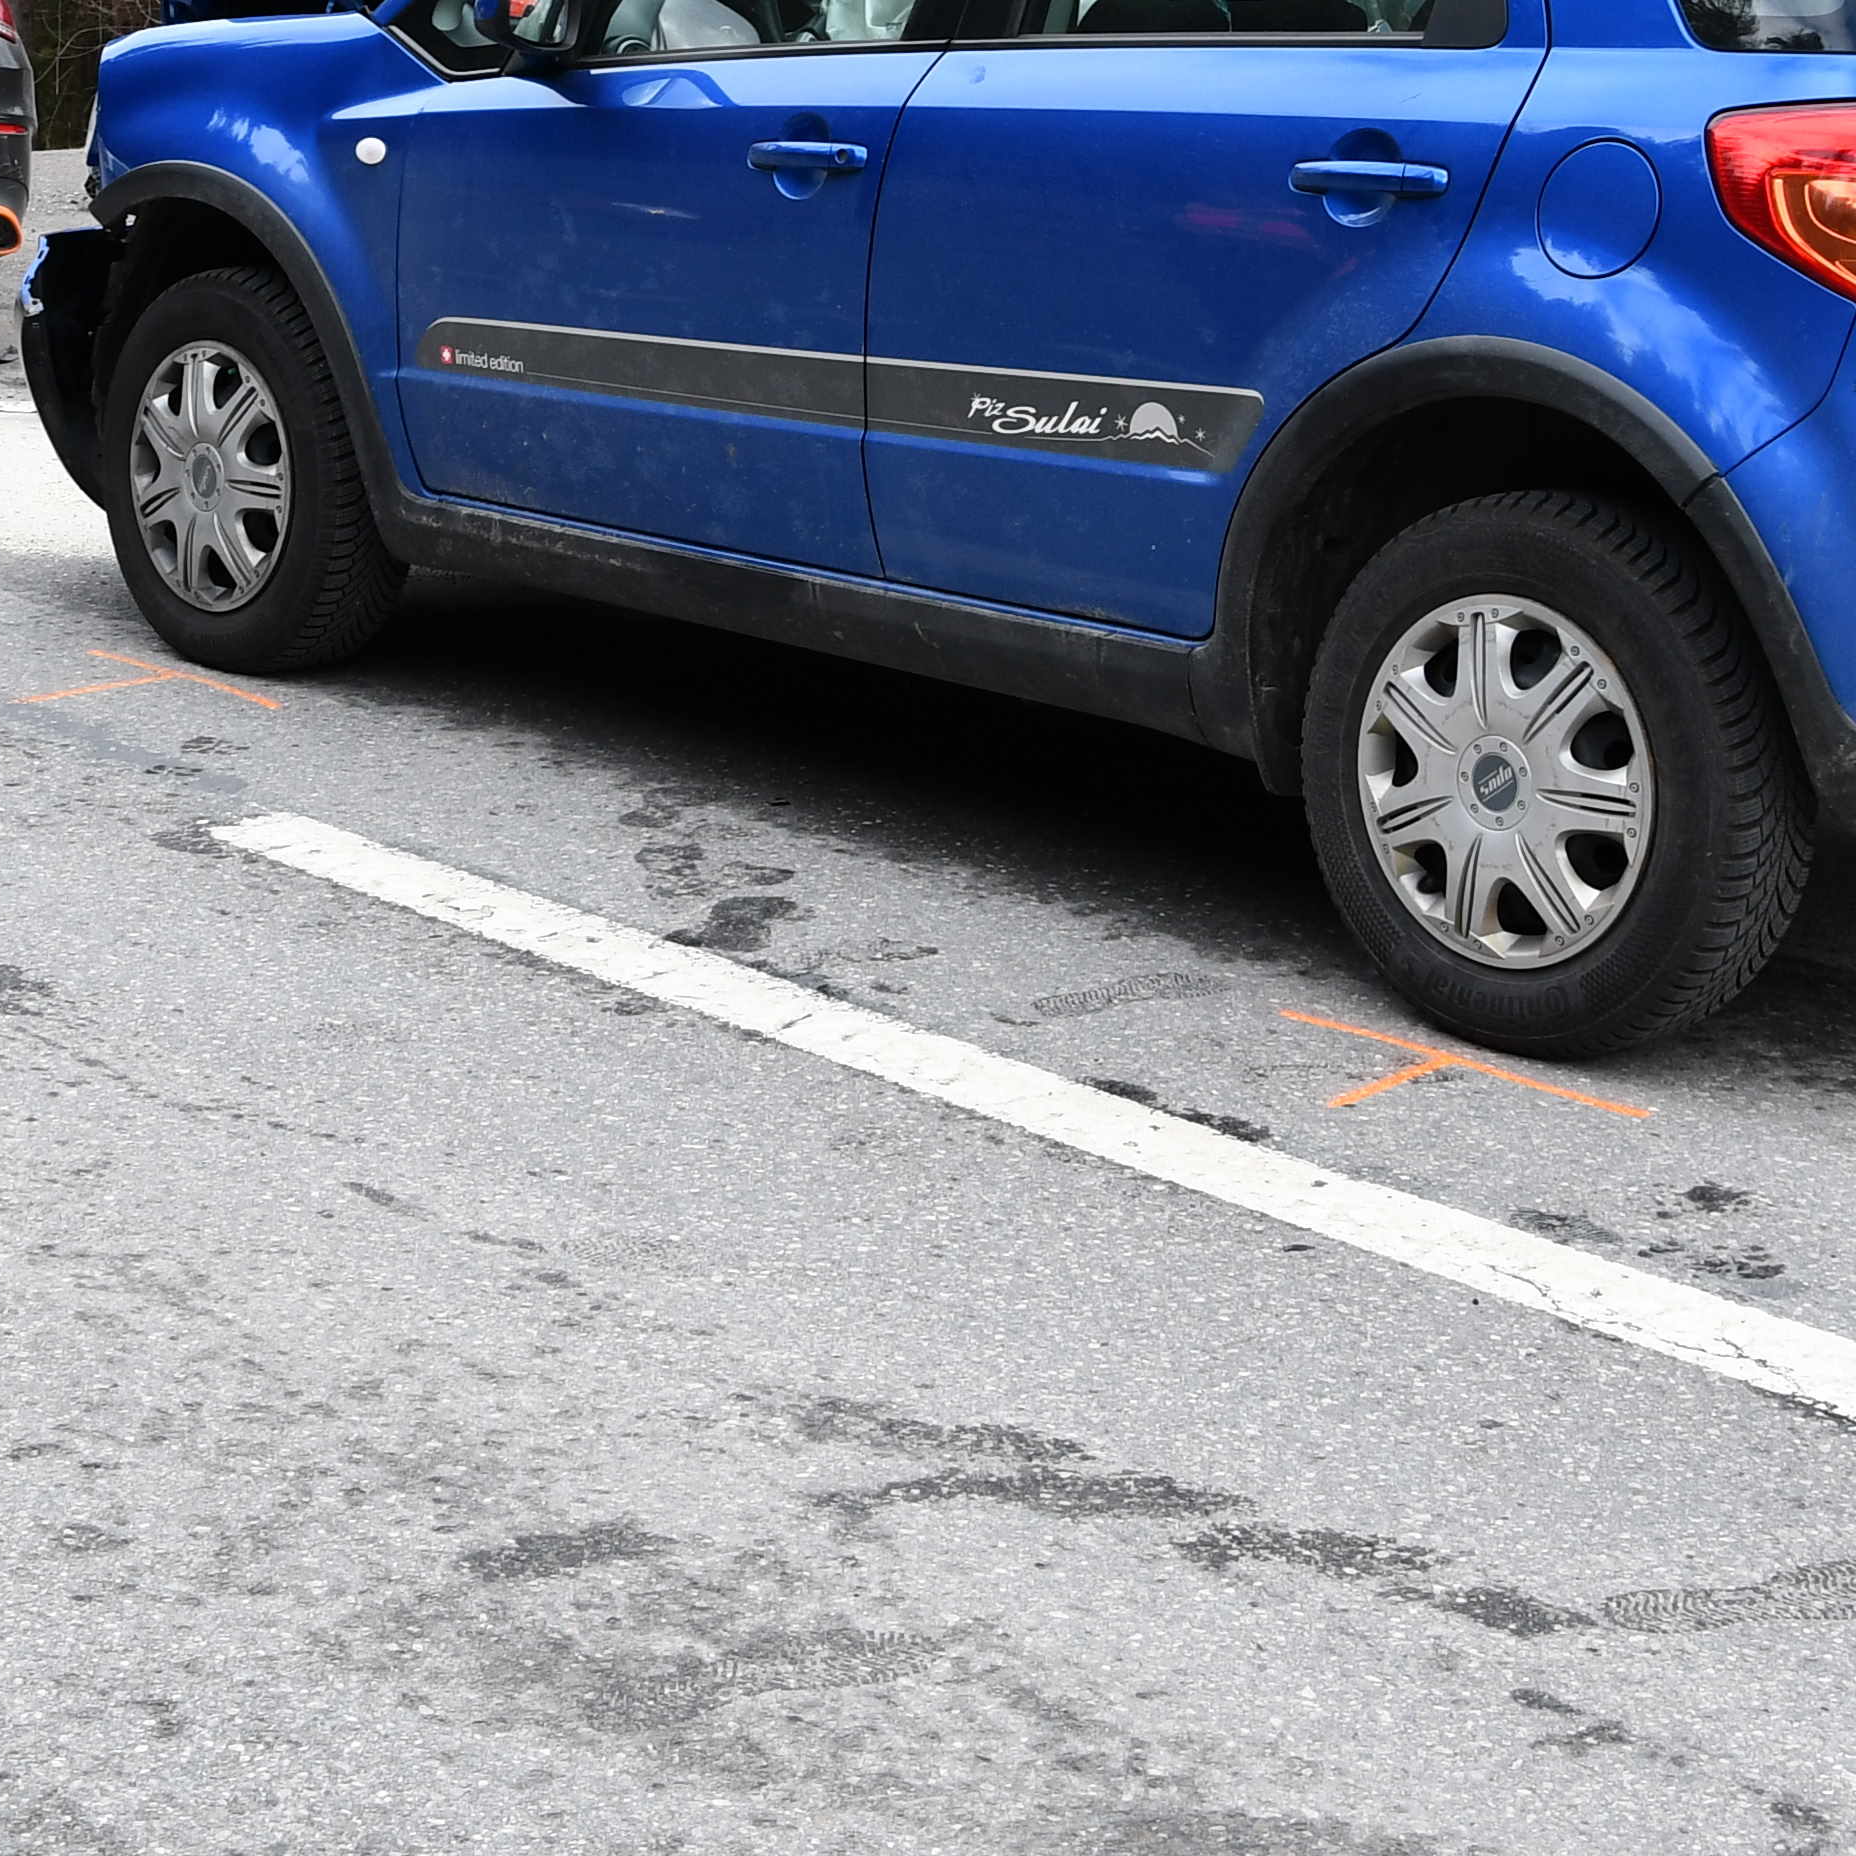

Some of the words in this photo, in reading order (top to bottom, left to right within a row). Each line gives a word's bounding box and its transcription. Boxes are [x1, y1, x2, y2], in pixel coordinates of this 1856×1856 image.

[455, 348, 489, 368] limited
[489, 355, 524, 374] edition
[967, 396, 1006, 418] Piz
[991, 401, 1108, 435] Sulai
